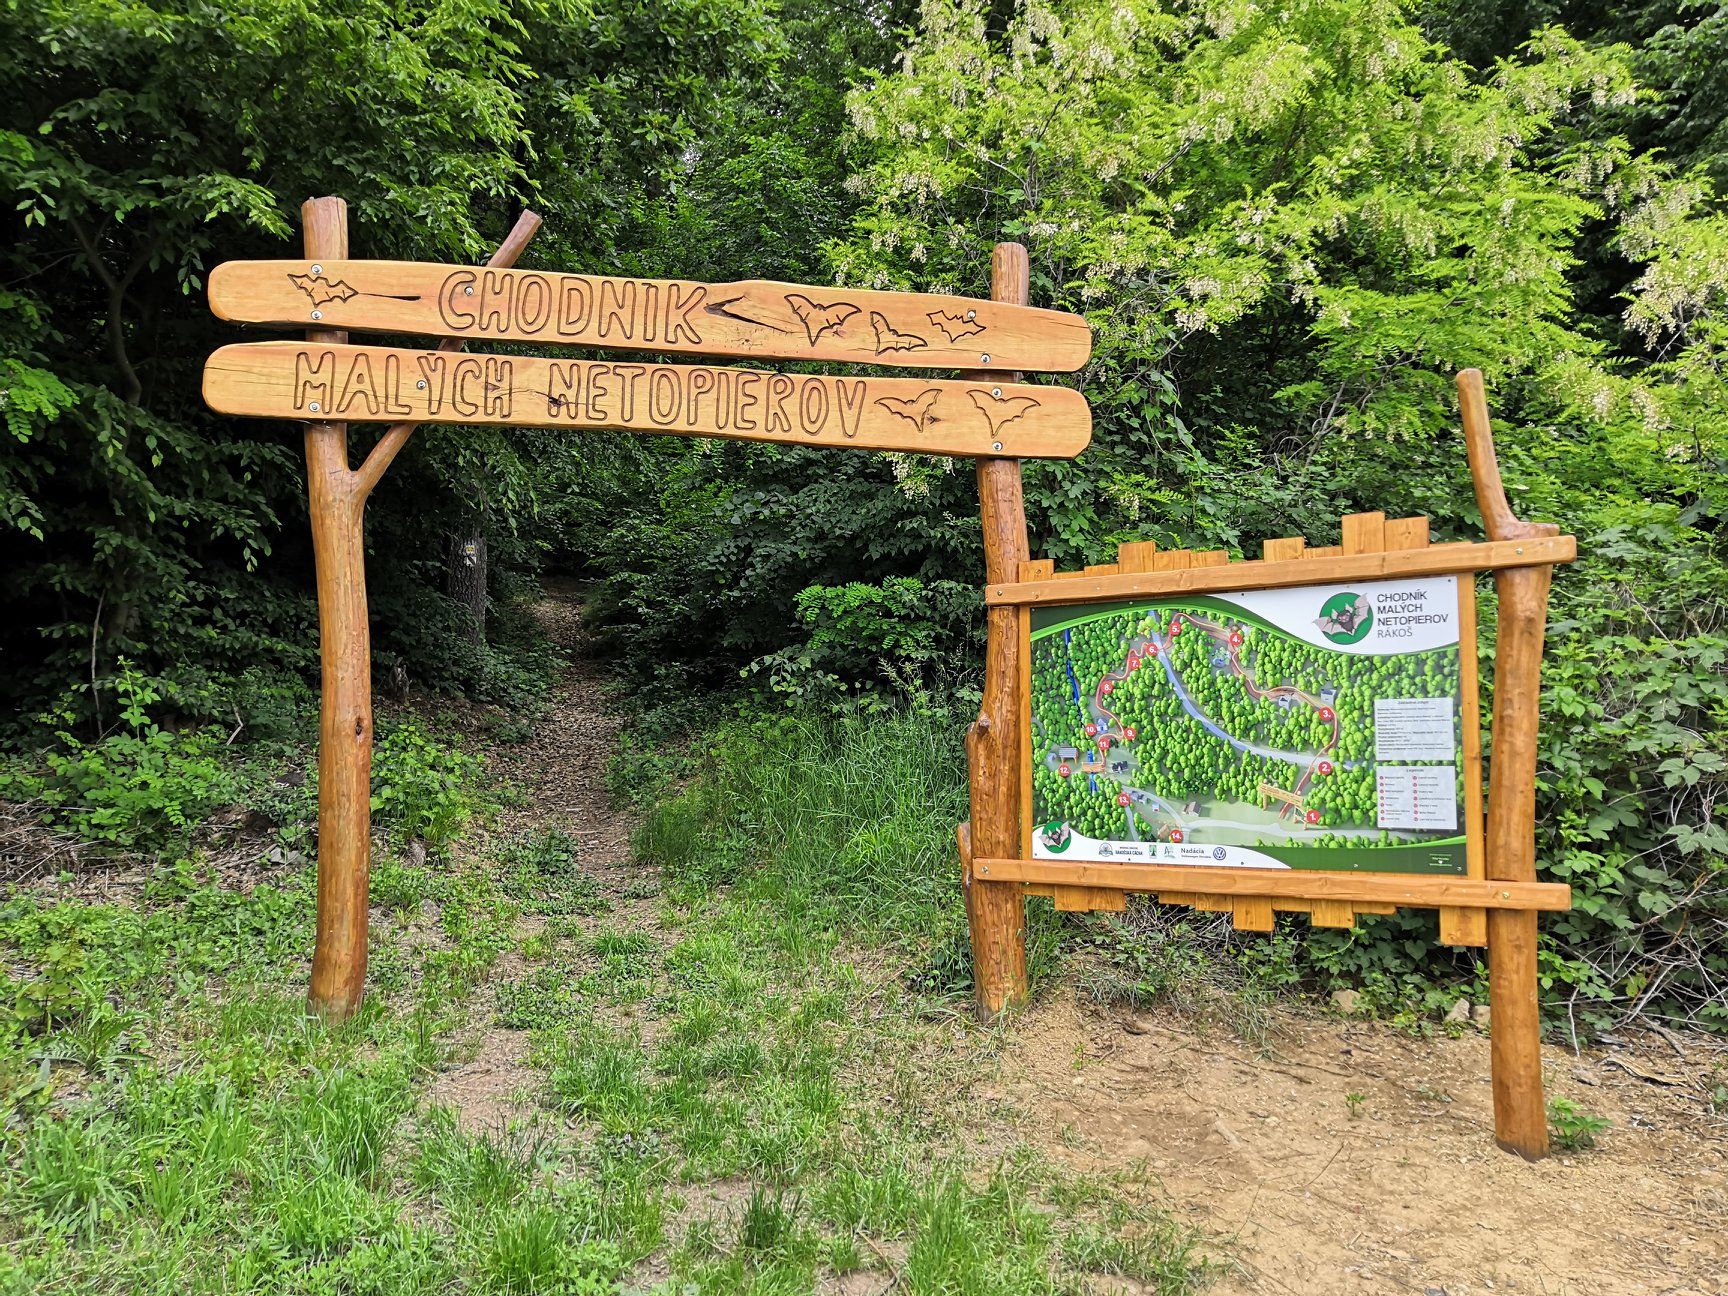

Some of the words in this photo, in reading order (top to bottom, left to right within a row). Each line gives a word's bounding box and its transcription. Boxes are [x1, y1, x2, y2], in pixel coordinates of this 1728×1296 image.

[547, 363, 867, 439] NETOPIEROV
[1377, 588, 1427, 602] CHODNÍK
[1377, 602, 1423, 614] MALÝCH
[1377, 613, 1449, 626] NETOPIEROV
[1377, 625, 1413, 638] RÁKOŠ
[1322, 710, 1331, 718] 3.
[1321, 764, 1330, 772] 2.
[1310, 813, 1317, 821] 1.
